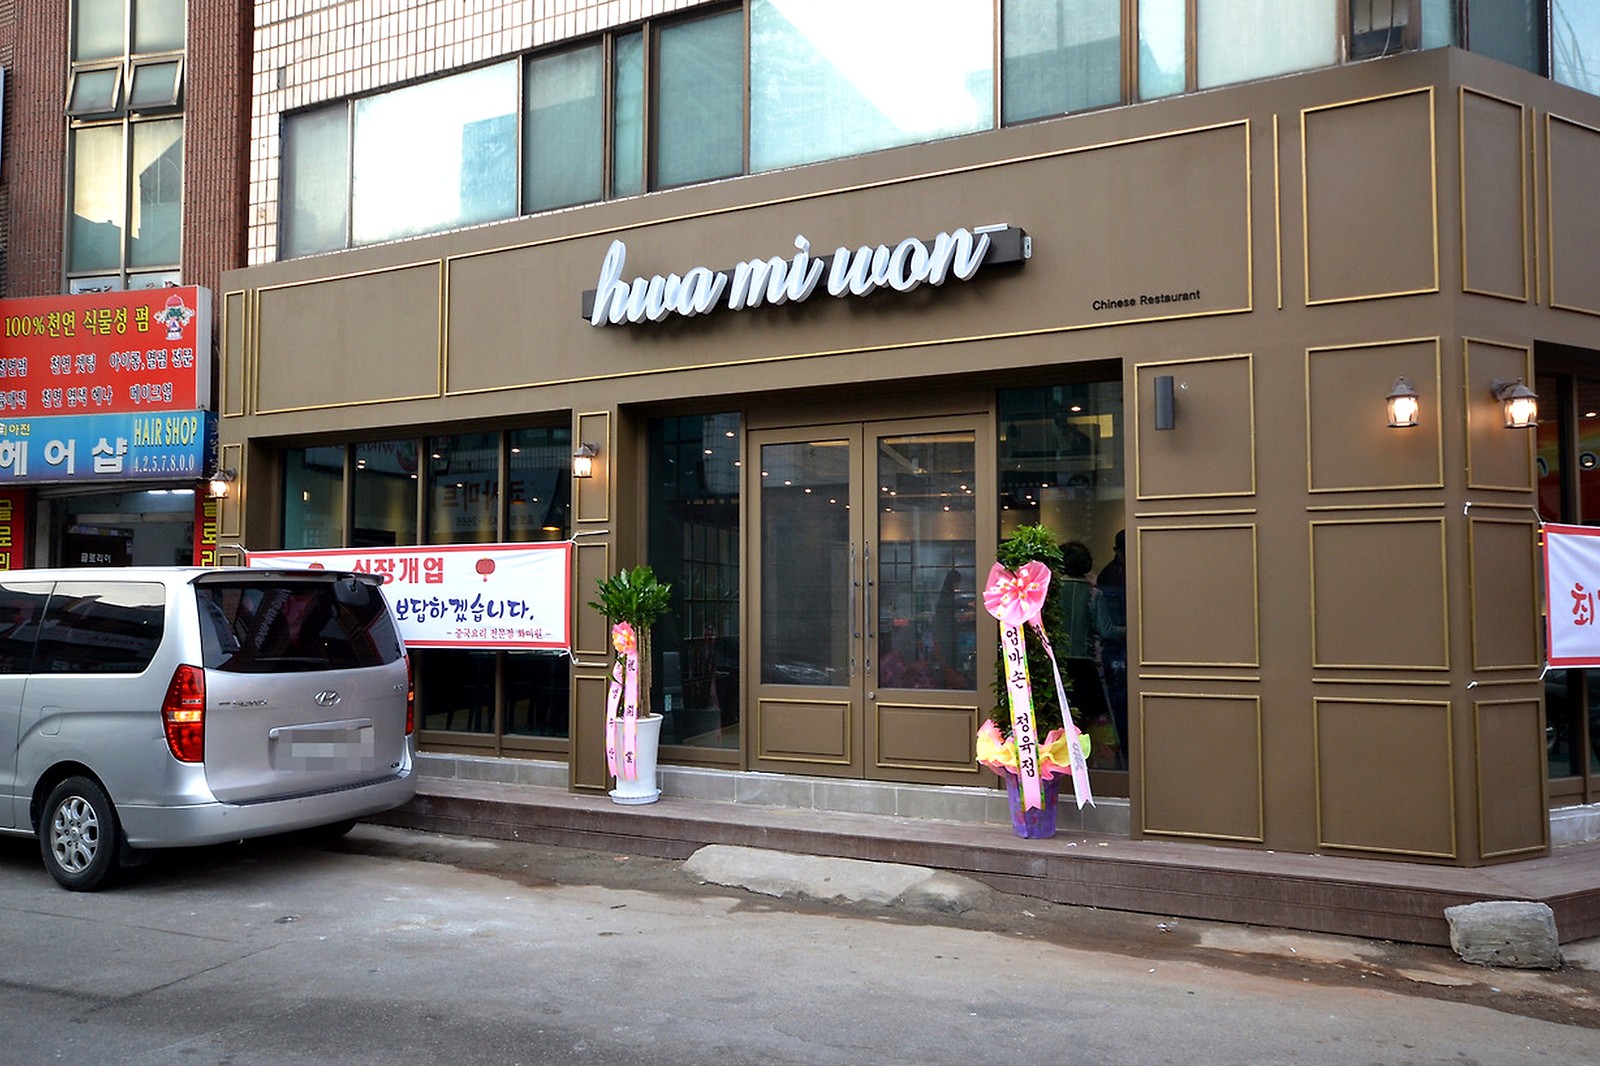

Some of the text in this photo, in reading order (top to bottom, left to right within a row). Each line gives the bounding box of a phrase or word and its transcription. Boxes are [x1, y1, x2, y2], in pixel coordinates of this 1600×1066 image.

[591, 226, 991, 327] hwa mi won
[1092, 289, 1201, 311] Chinese Restaurant
[83, 306, 128, 336] 식물성
[135, 304, 150, 333] 펌
[130, 382, 173, 404] 메이크업
[134, 418, 162, 447] HAIR
[165, 416, 197, 446] SHOP
[396, 593, 534, 623] 보답하겠습니다.
[1006, 626, 1036, 778] 엄마손 정육점
